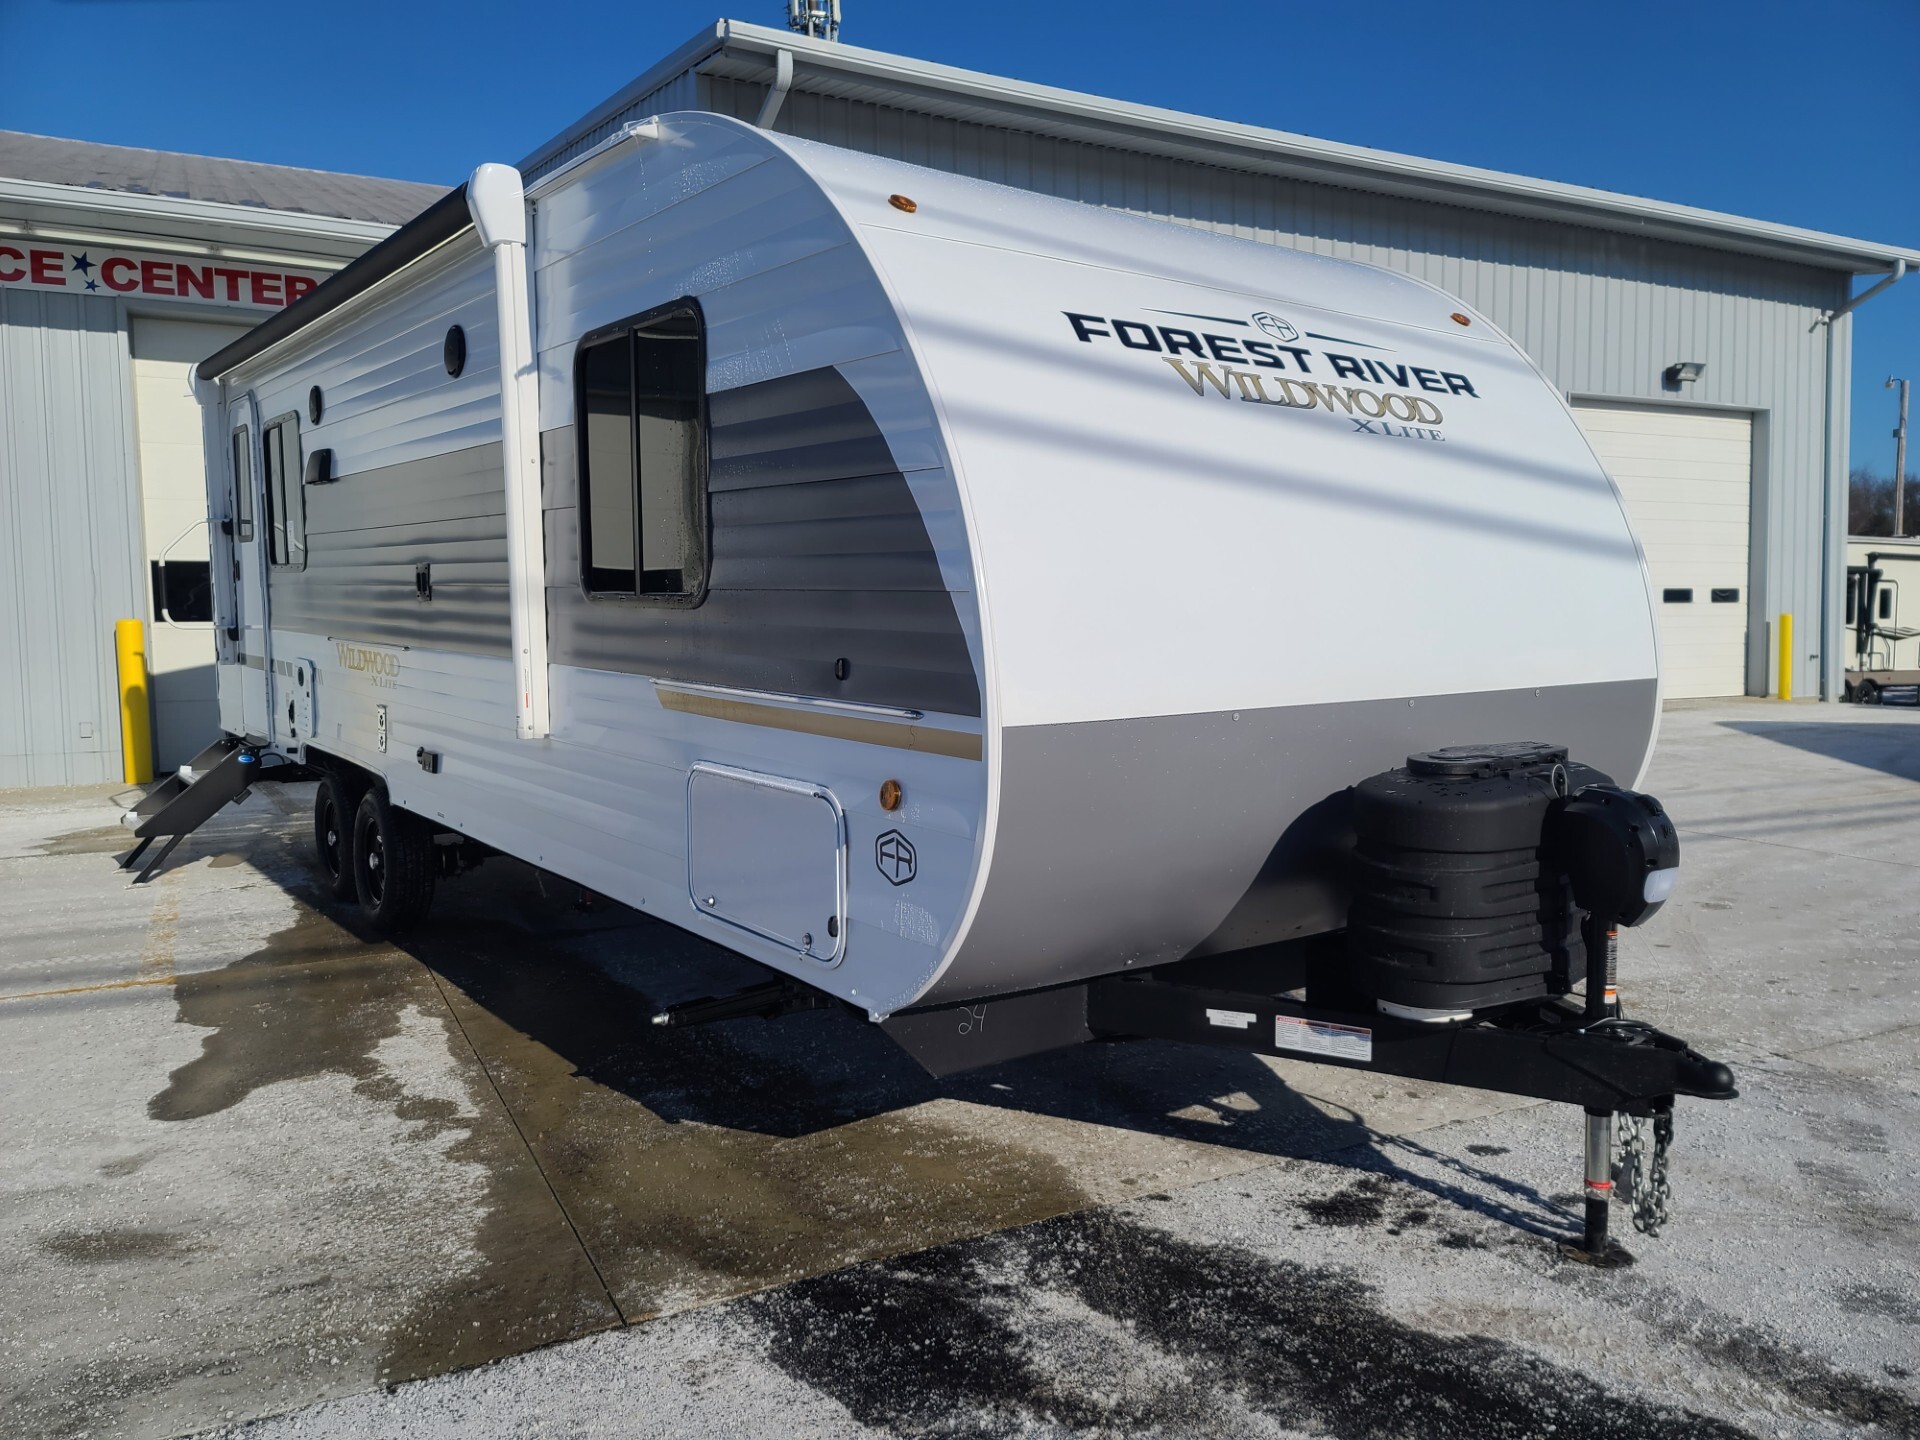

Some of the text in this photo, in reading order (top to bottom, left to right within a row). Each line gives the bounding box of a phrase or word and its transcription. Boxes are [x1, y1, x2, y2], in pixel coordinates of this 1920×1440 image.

[1060, 311, 1481, 399] FOREST RIVER
[1161, 356, 1444, 425] WILDWOOD
[336, 642, 401, 677] WILDWOOD
[958, 1004, 987, 1034] 24
